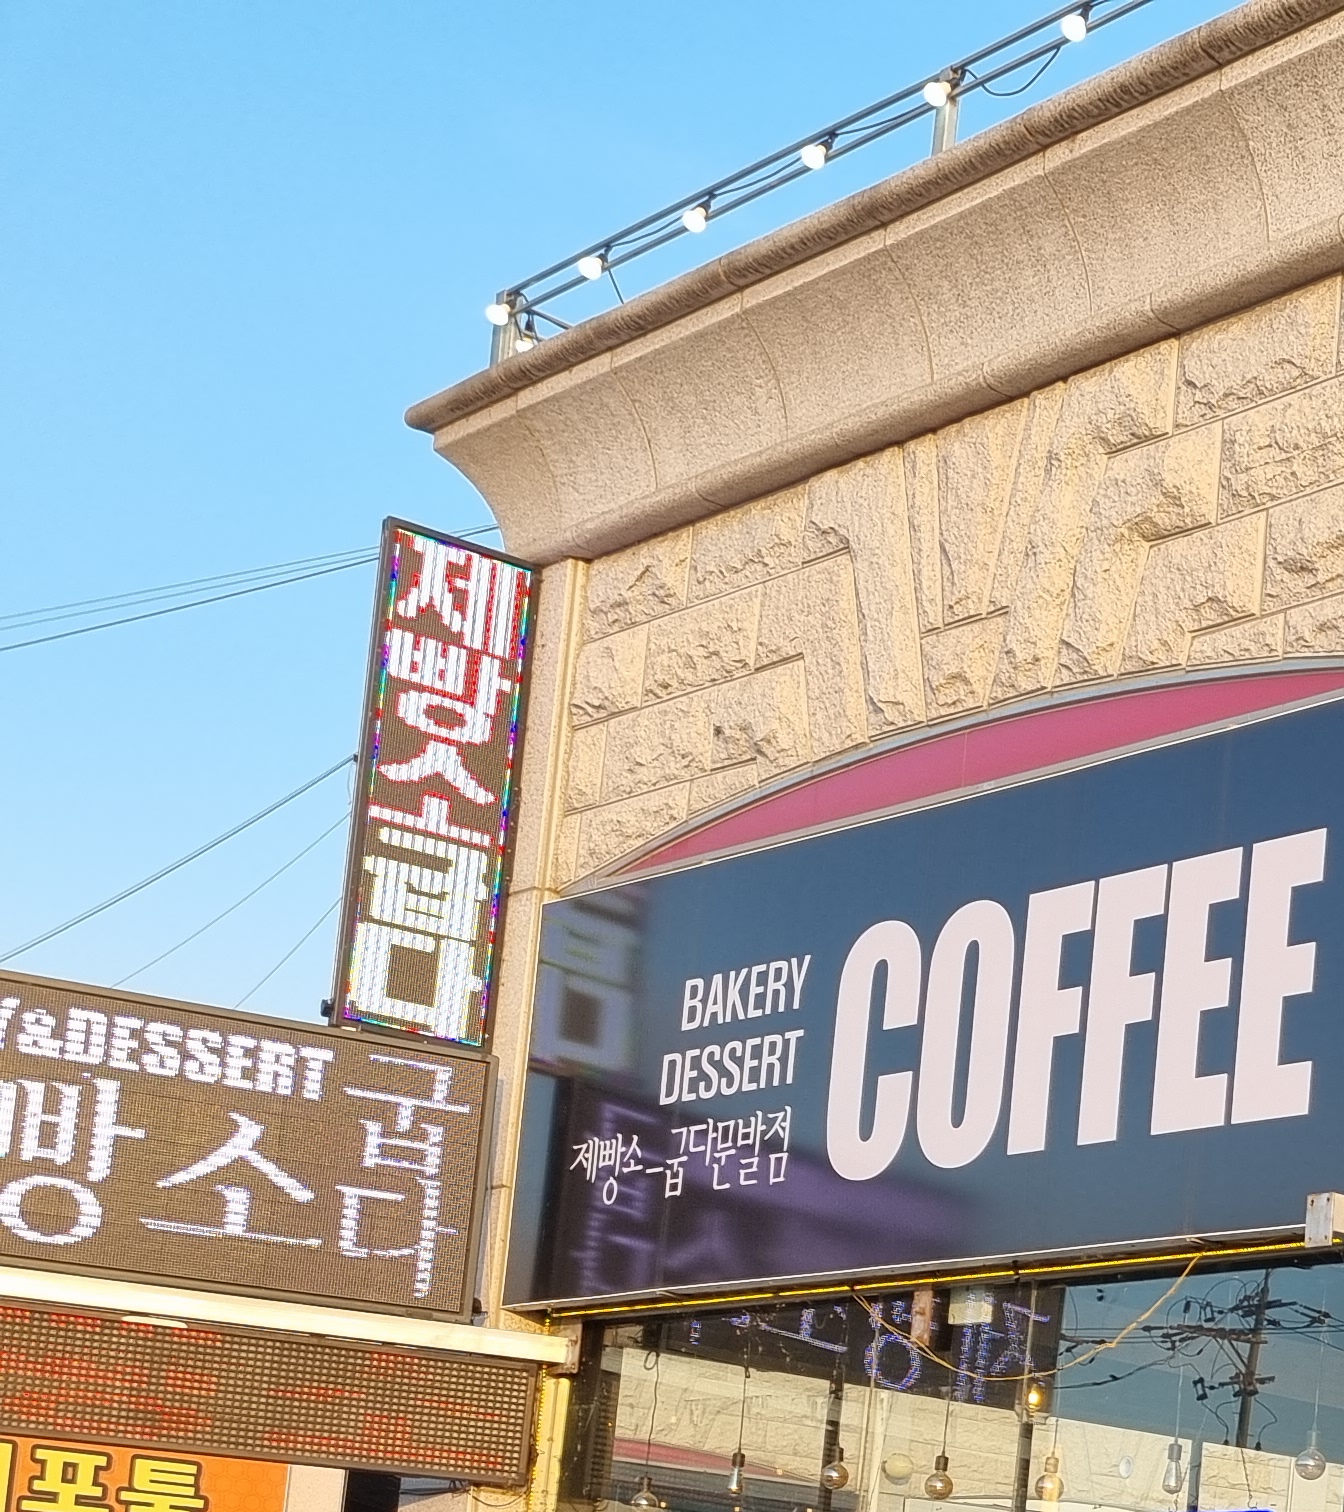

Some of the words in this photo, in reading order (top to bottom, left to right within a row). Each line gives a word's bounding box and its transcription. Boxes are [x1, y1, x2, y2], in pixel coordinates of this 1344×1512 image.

[680, 954, 812, 1032] BAKERY
[826, 827, 1328, 1181] COFFEE
[659, 1029, 804, 1106] DESSERT
